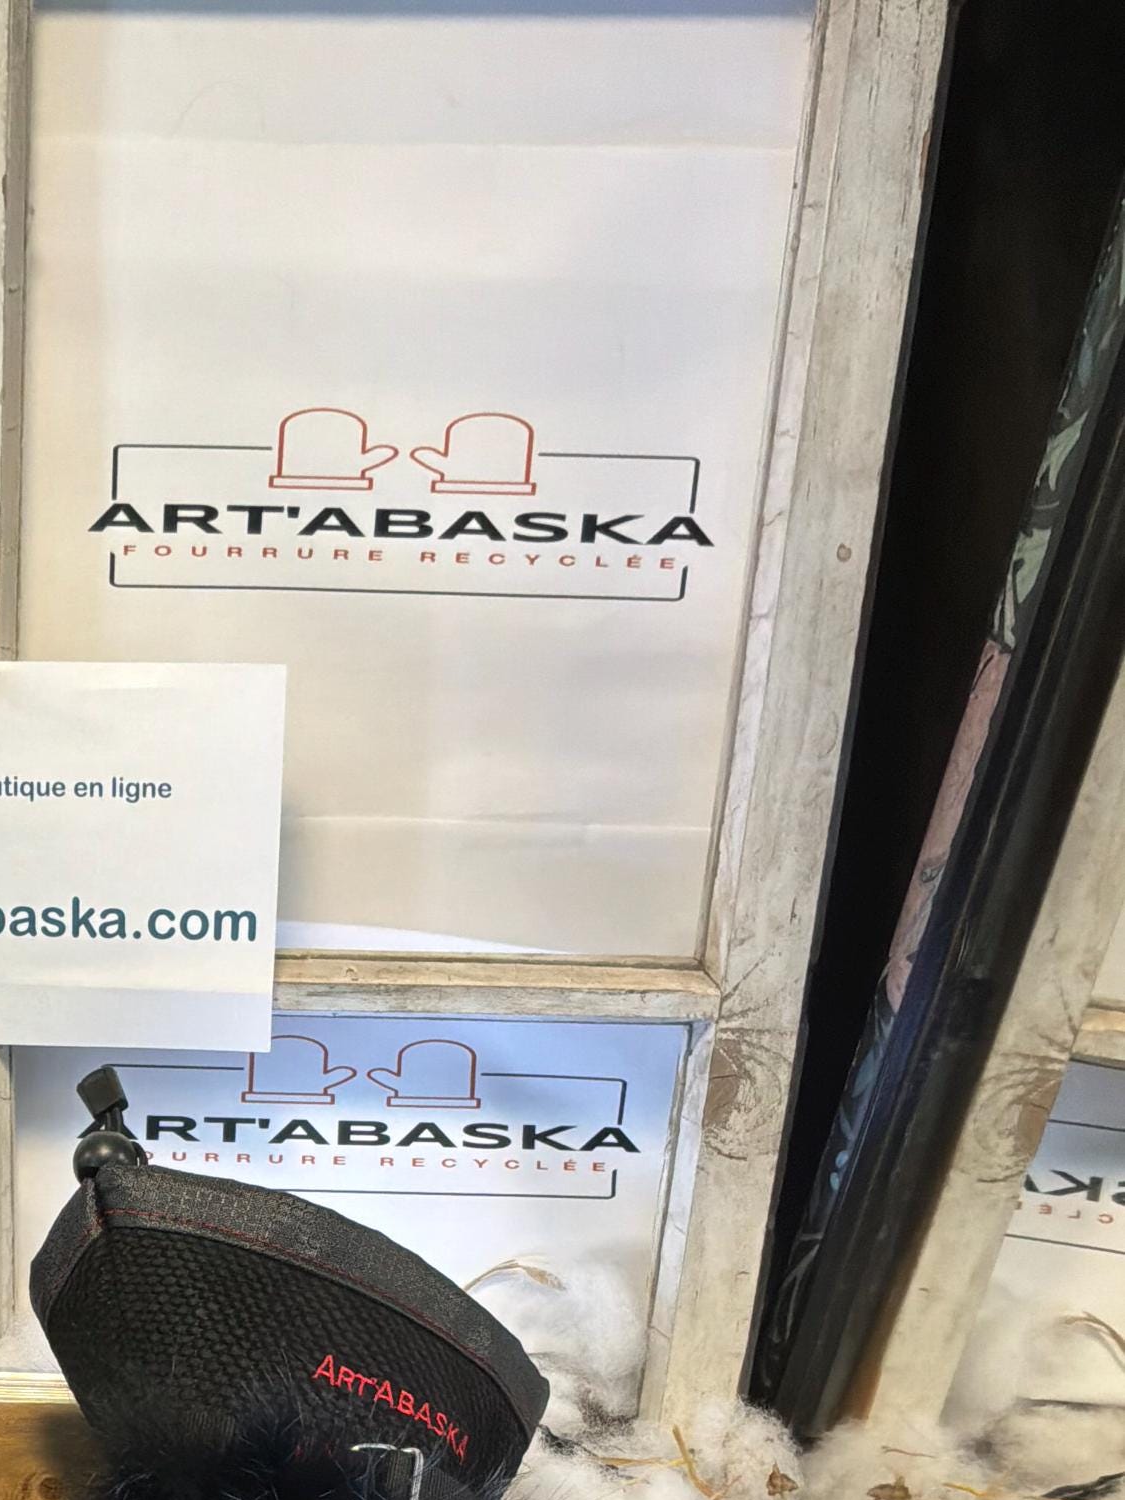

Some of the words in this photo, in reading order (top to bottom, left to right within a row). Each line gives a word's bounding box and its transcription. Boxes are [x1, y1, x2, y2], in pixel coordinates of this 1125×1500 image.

[88, 503, 715, 547] ART'ABASKA
[122, 544, 383, 564] FOURRURE
[420, 551, 678, 571] RECYCLÉE
[73, 781, 103, 799] en
[112, 776, 173, 803] ligne
[380, 1157, 607, 1173] RECYCLÉE
